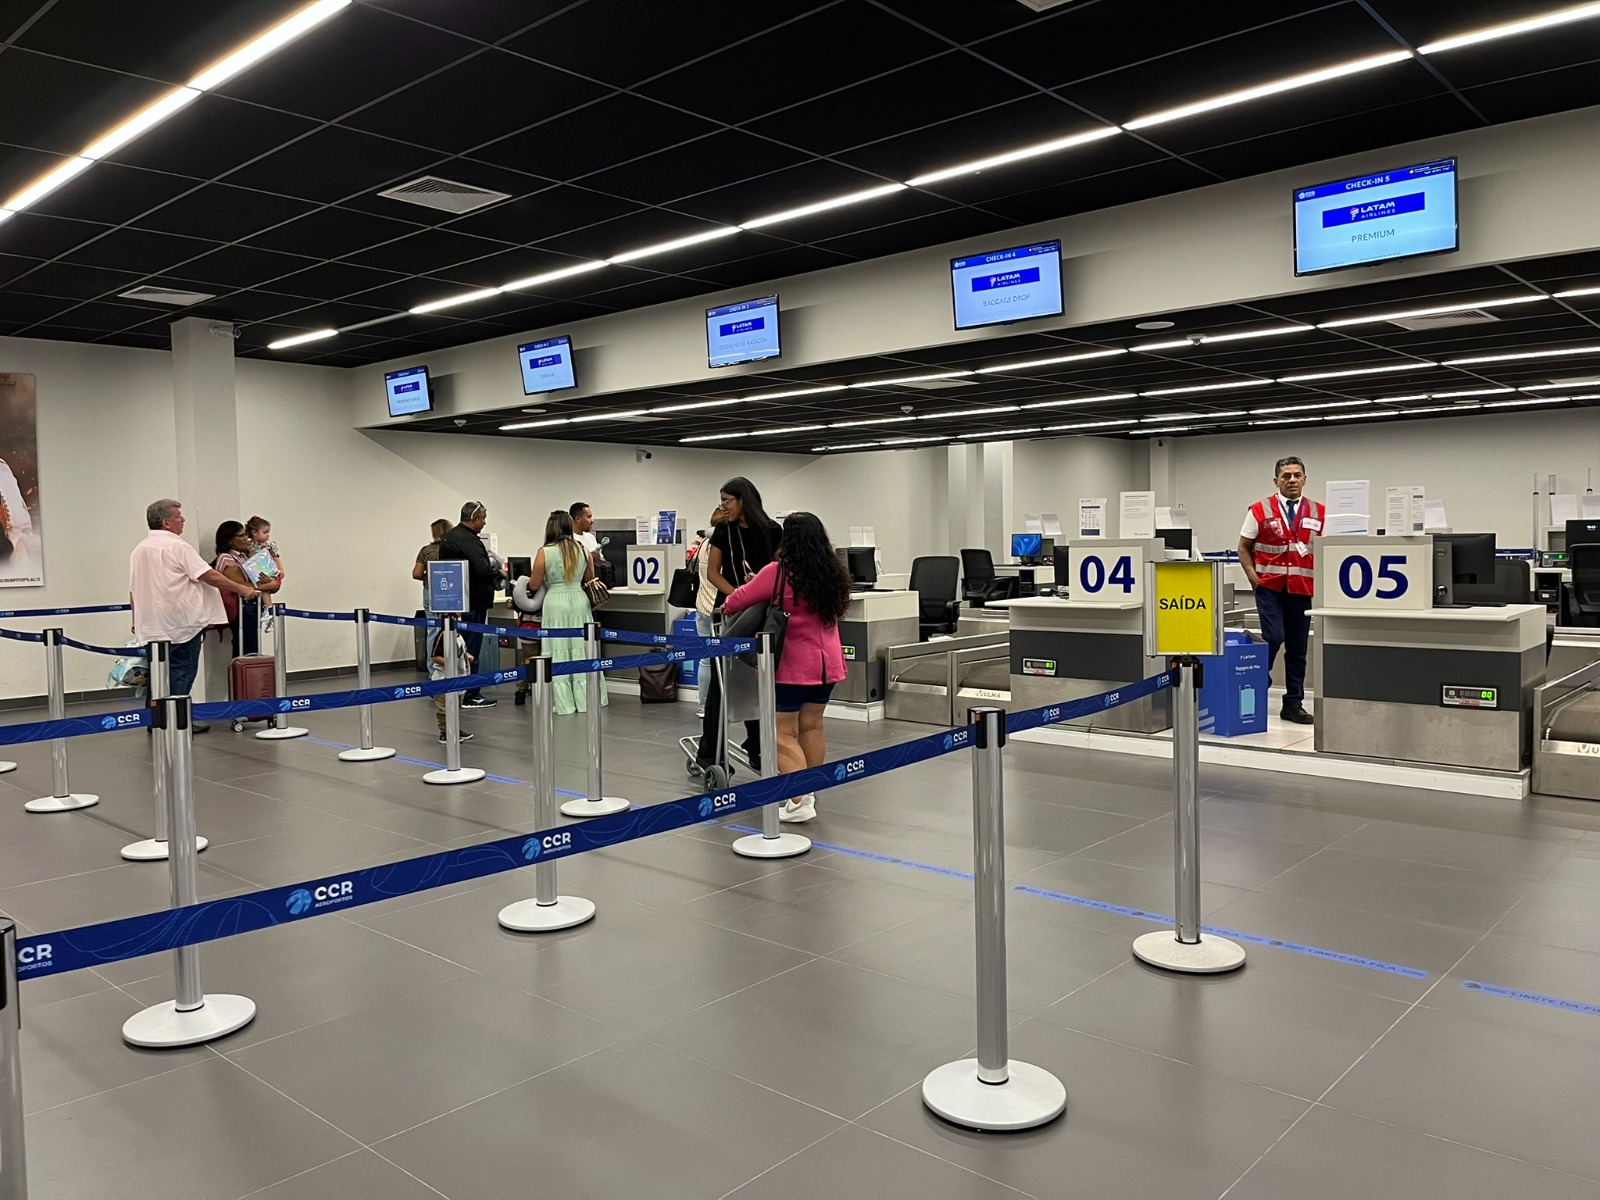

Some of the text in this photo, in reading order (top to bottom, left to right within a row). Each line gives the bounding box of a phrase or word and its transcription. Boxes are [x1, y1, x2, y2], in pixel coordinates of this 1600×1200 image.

[1345, 177, 1383, 190] CHECK-IN
[1361, 201, 1395, 213] LATAM
[1361, 208, 1396, 219] AIRLINES
[1352, 229, 1395, 243] PREMIUM
[985, 253, 1011, 262] CHECK-IN
[997, 273, 1021, 282] LATAM
[983, 294, 1030, 306] BAGGAGE DROP
[633, 557, 660, 585] 02
[1079, 555, 1135, 594] 04
[1339, 555, 1409, 599] 05
[1159, 594, 1206, 610] SAÍDA
[503, 670, 518, 679] CCR
[405, 686, 421, 694] CCR
[292, 698, 311, 707] CCR
[117, 713, 140, 723] CCR
[953, 730, 968, 742] CCR
[846, 759, 865, 773] CCR
[714, 792, 736, 807] CCR
[542, 832, 571, 848] CCR
[314, 880, 353, 901] CCR
[314, 895, 353, 908] AEROPORTOS
[18, 943, 53, 963] CR
[1307, 948, 1396, 972] LIMITE DA FILA
[1511, 992, 1555, 1004] LIMITE
[1559, 1001, 1579, 1009] DA
